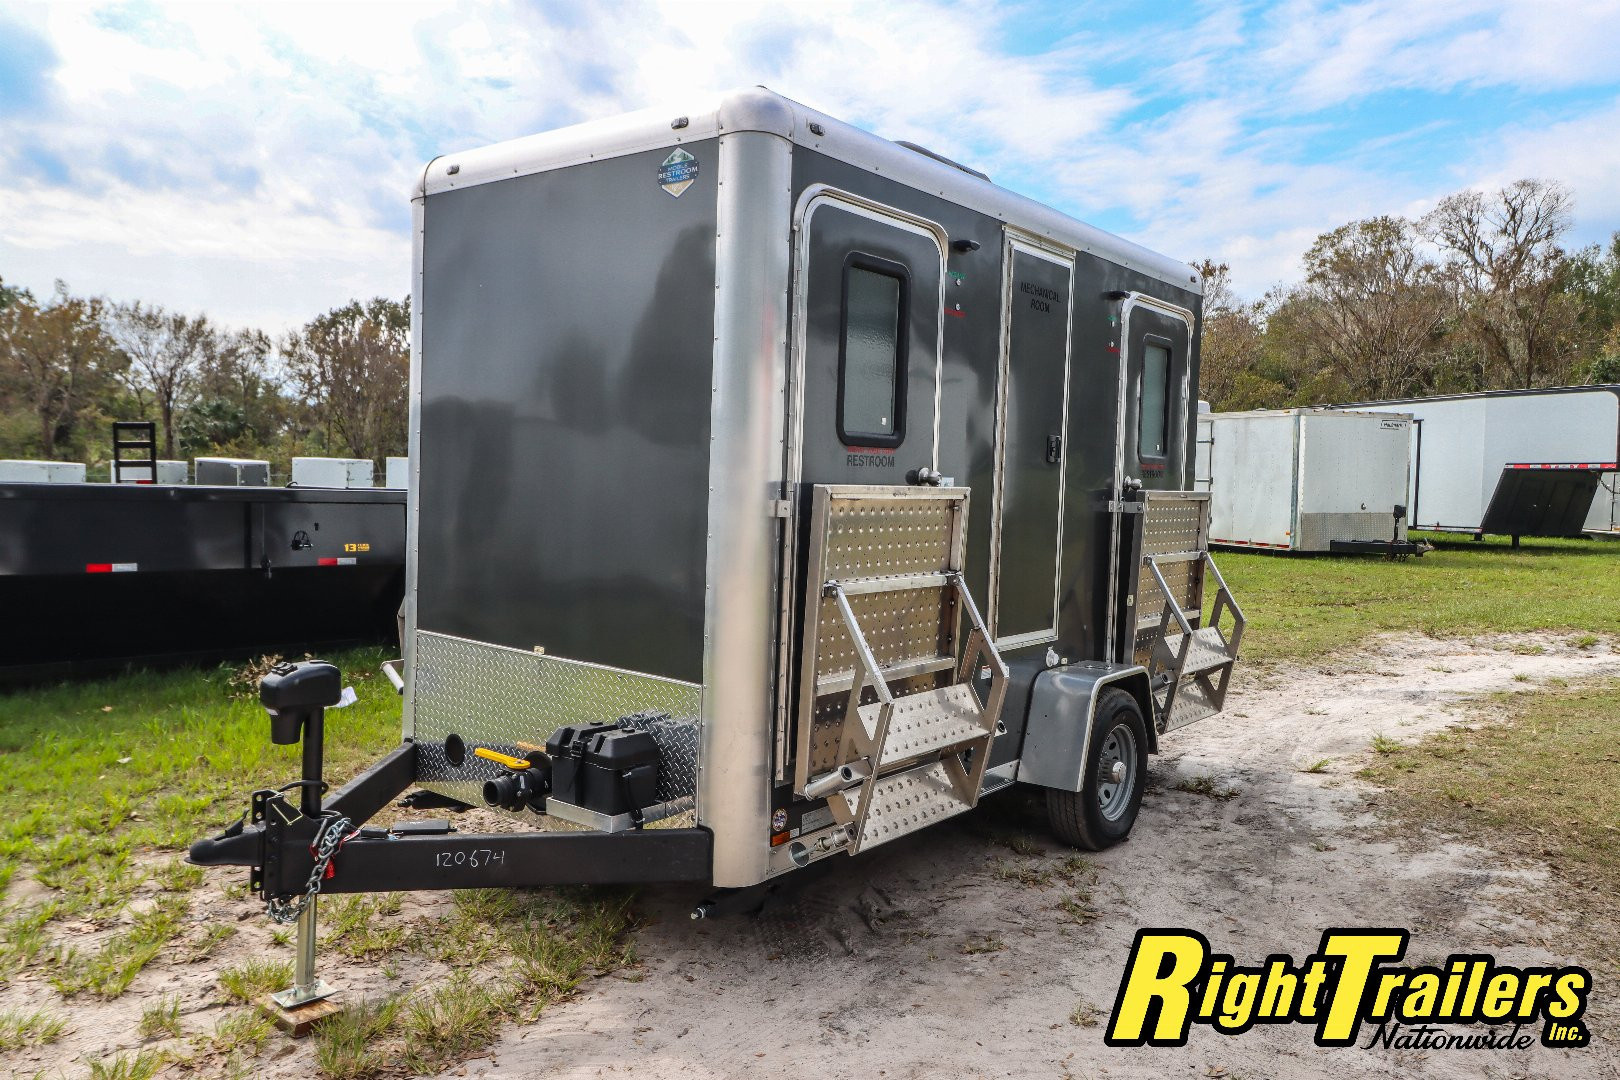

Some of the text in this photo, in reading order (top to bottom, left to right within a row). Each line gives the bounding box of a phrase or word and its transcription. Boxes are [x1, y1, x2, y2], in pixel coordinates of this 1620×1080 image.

[658, 166, 698, 179] RESTROOM
[1020, 281, 1061, 303] MECHANICAL
[1030, 298, 1050, 313] ROOM
[846, 454, 895, 468] RESTROOM
[436, 849, 505, 868] 120674
